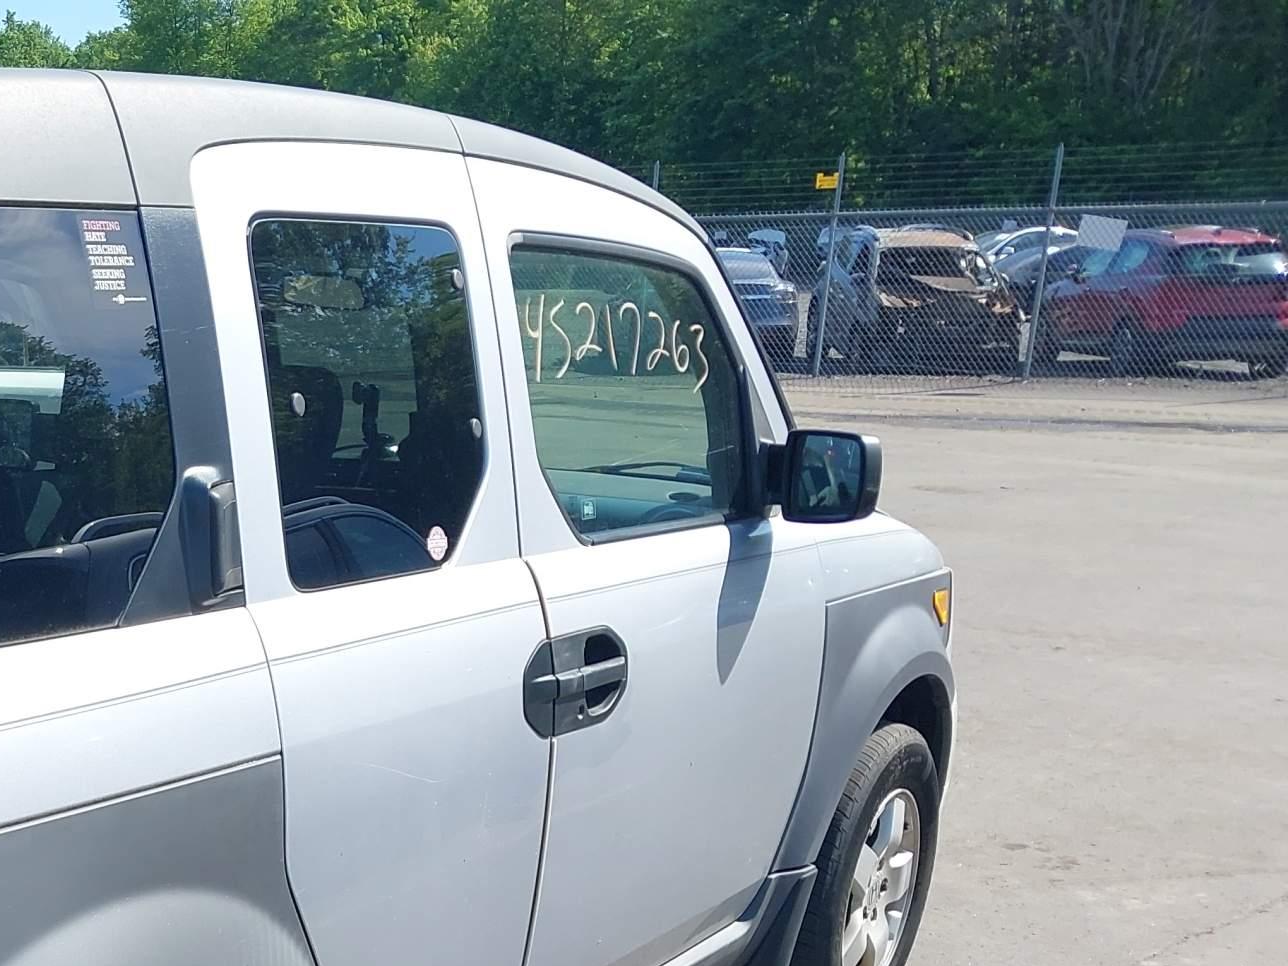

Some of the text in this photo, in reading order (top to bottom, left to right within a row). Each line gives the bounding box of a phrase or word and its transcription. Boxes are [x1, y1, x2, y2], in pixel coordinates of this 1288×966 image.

[82, 220, 120, 231] FIGHTING
[84, 231, 106, 242] HATE
[85, 244, 127, 255] TEACHING
[88, 256, 135, 266] TOLERANCE
[92, 269, 126, 279] SEEKING
[94, 280, 126, 290] JUSTICE
[526, 294, 709, 394] 45217263
